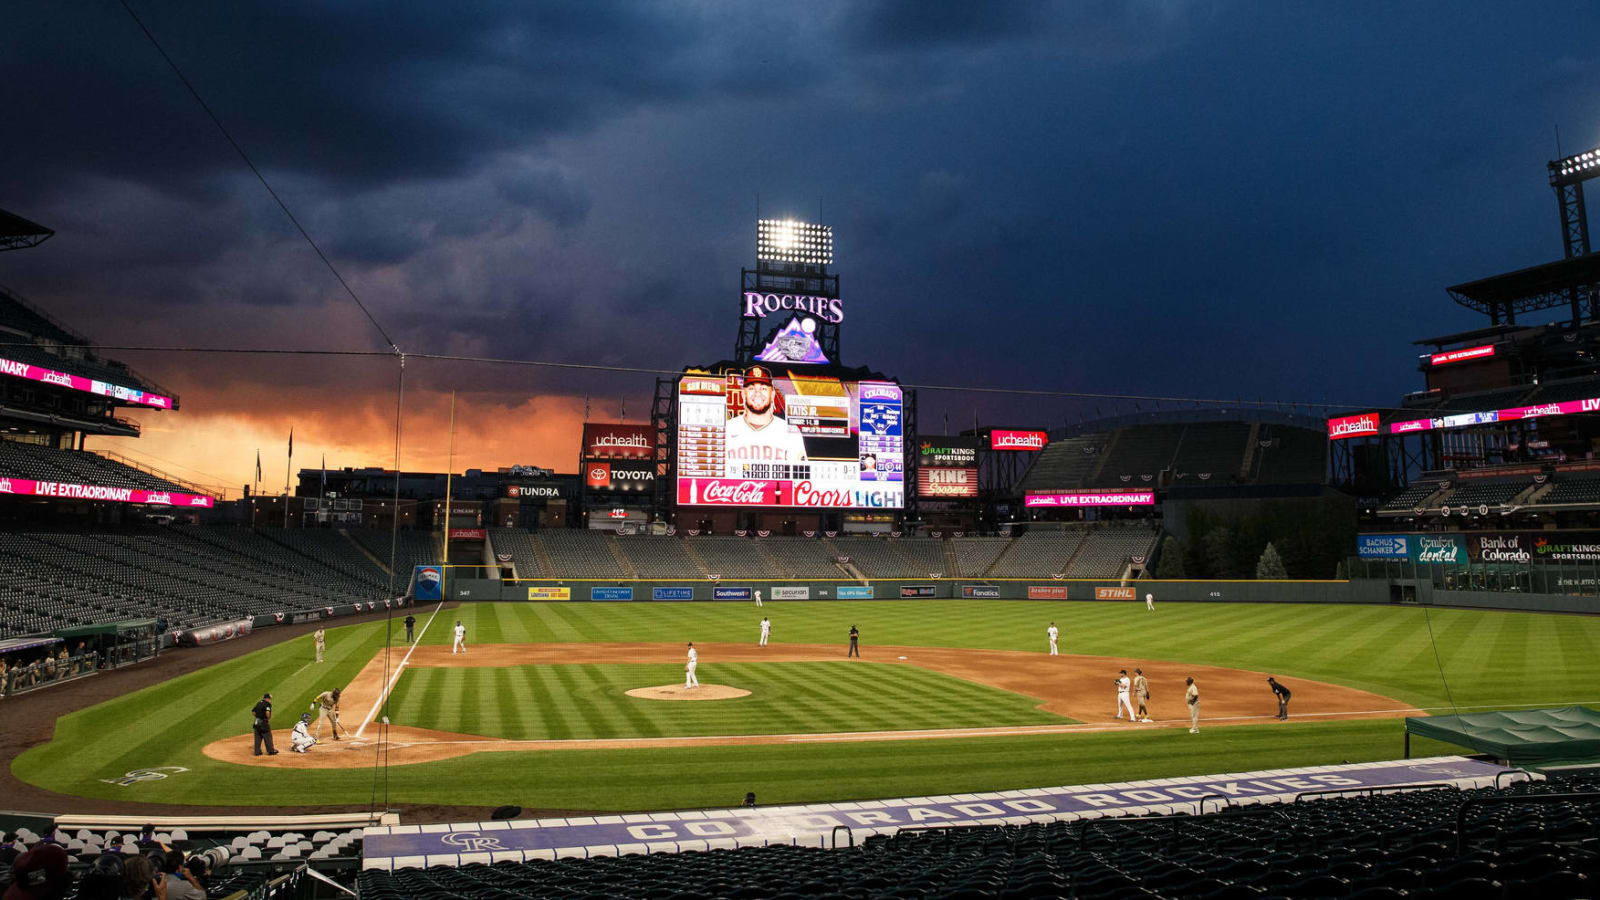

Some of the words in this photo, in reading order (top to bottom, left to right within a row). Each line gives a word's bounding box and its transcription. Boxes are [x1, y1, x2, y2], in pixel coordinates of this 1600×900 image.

[744, 292, 844, 323] ROCKIES
[44, 371, 72, 386] uchealth
[790, 405, 808, 416] TATIS
[1525, 404, 1560, 416] uchealth
[1333, 417, 1373, 433] uchealth
[596, 432, 647, 447] uchealth
[998, 433, 1042, 446] uchealth
[921, 447, 975, 455] DRAFTKINGS
[611, 470, 654, 480] TOYOTA
[928, 470, 968, 483] KING
[36, 481, 57, 496] LIVE
[59, 483, 132, 501] EXTRAORDINARY
[519, 487, 559, 496] TUNDRA
[703, 480, 768, 503] Coca-Cola
[794, 481, 853, 506] Coors
[928, 482, 968, 494] Soopers
[147, 491, 171, 503] uchealth
[1060, 496, 1078, 504] LIVE
[1079, 495, 1151, 504] EXTRAORDINARY
[1420, 536, 1455, 548] Comfort
[1480, 536, 1507, 548] Bank
[1508, 535, 1519, 548] of
[1360, 546, 1393, 554] SCHANKER
[1419, 546, 1458, 562] dental
[1482, 548, 1530, 561] Colorado
[1074, 773, 1361, 808] ROCKIES
